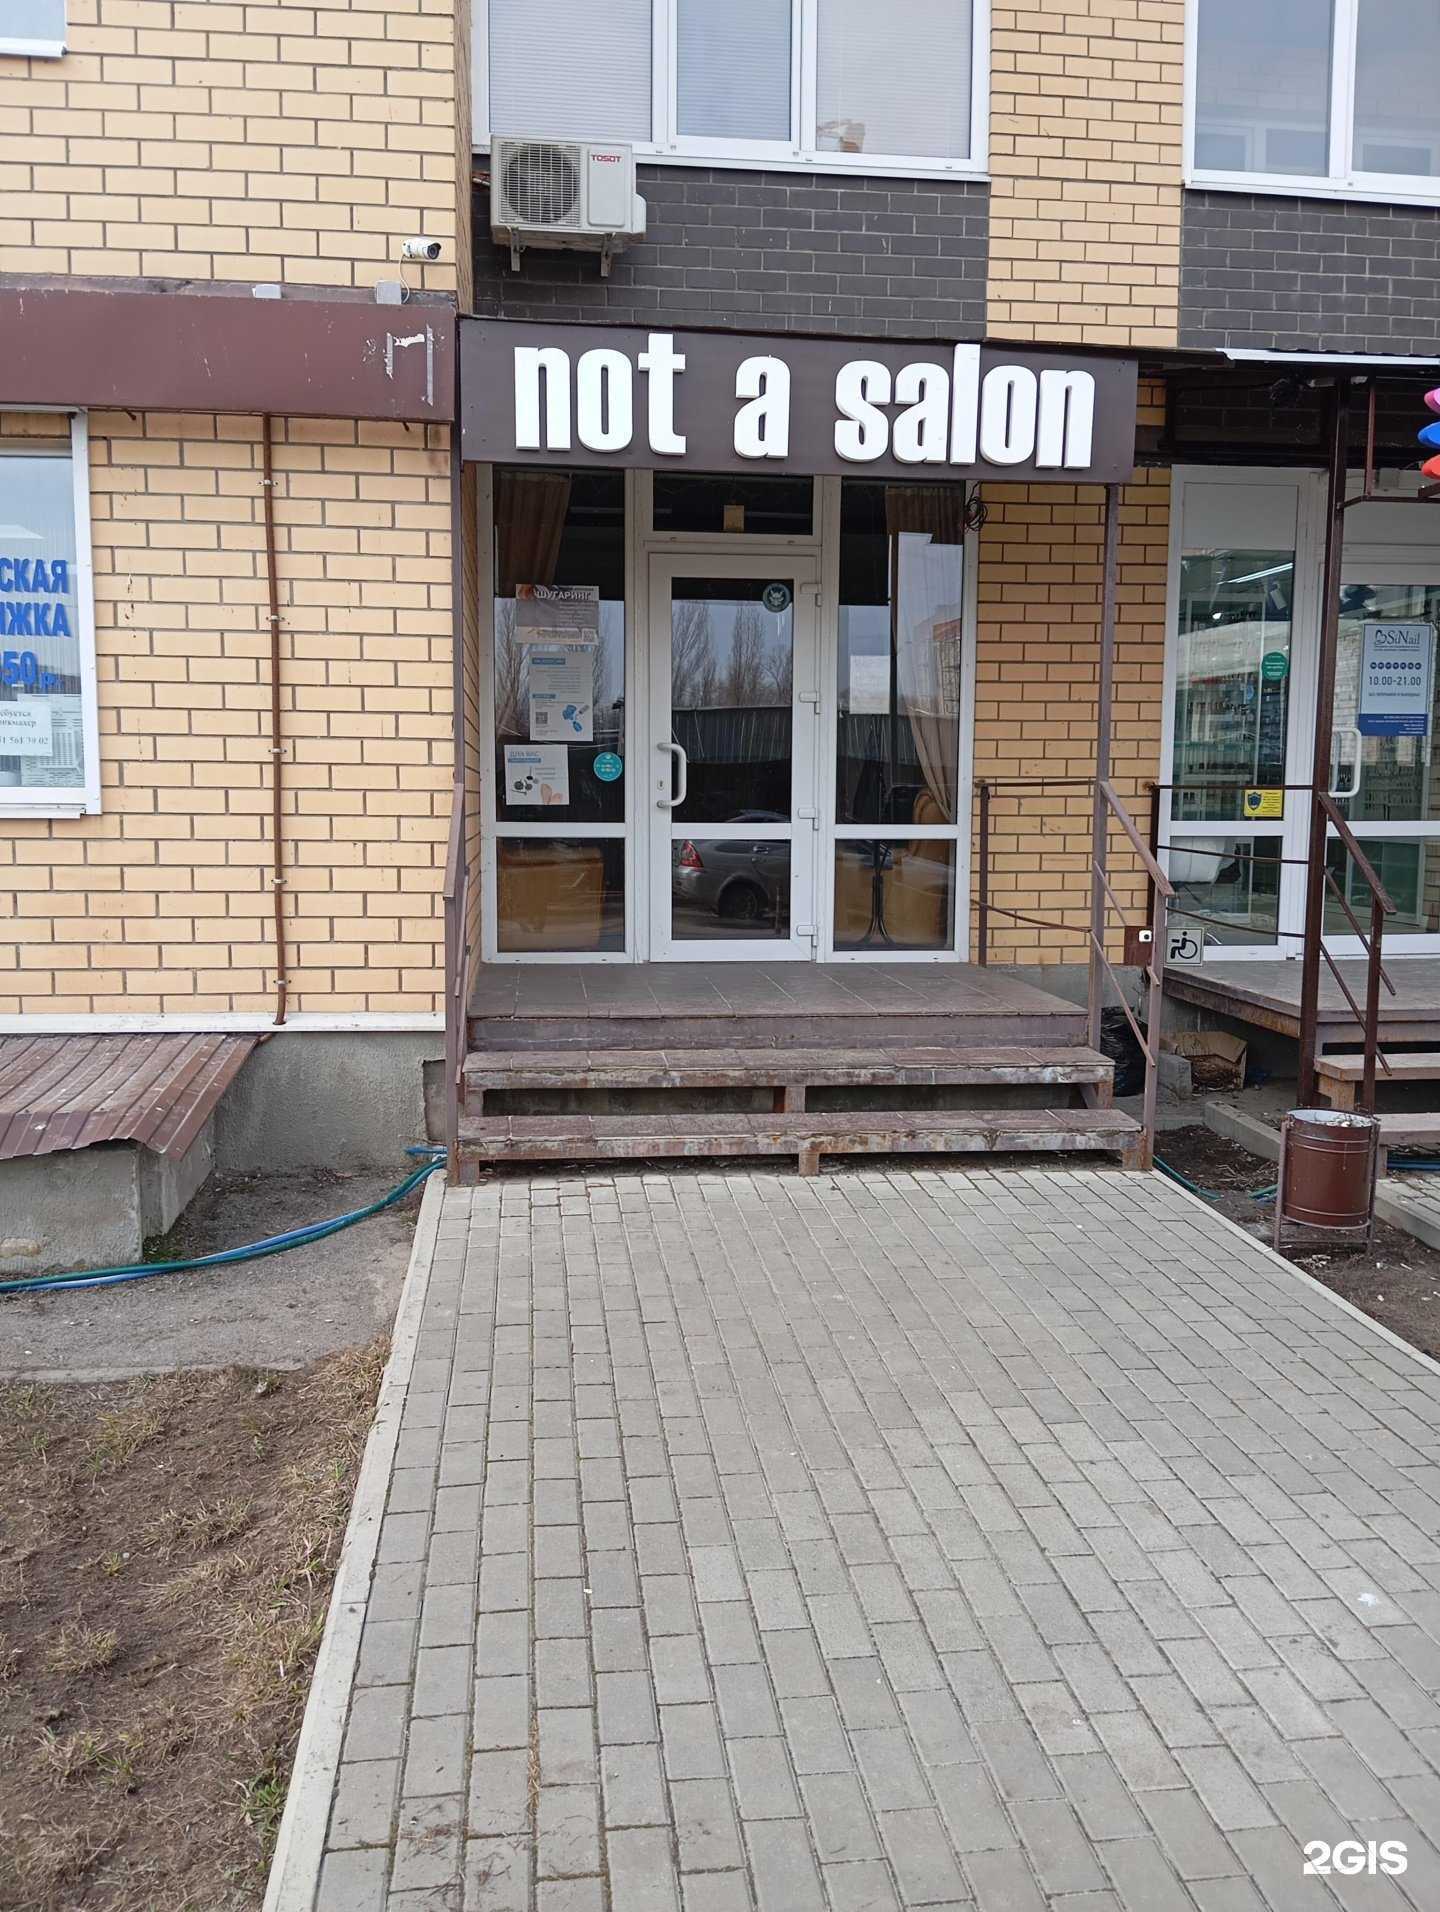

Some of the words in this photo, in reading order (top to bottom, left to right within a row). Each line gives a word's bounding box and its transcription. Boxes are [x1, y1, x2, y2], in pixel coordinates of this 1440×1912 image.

[514, 333, 687, 456] not
[733, 354, 792, 459] a
[833, 343, 1096, 468] salon
[0, 557, 70, 594] СКАЯ
[0, 651, 37, 687] 50
